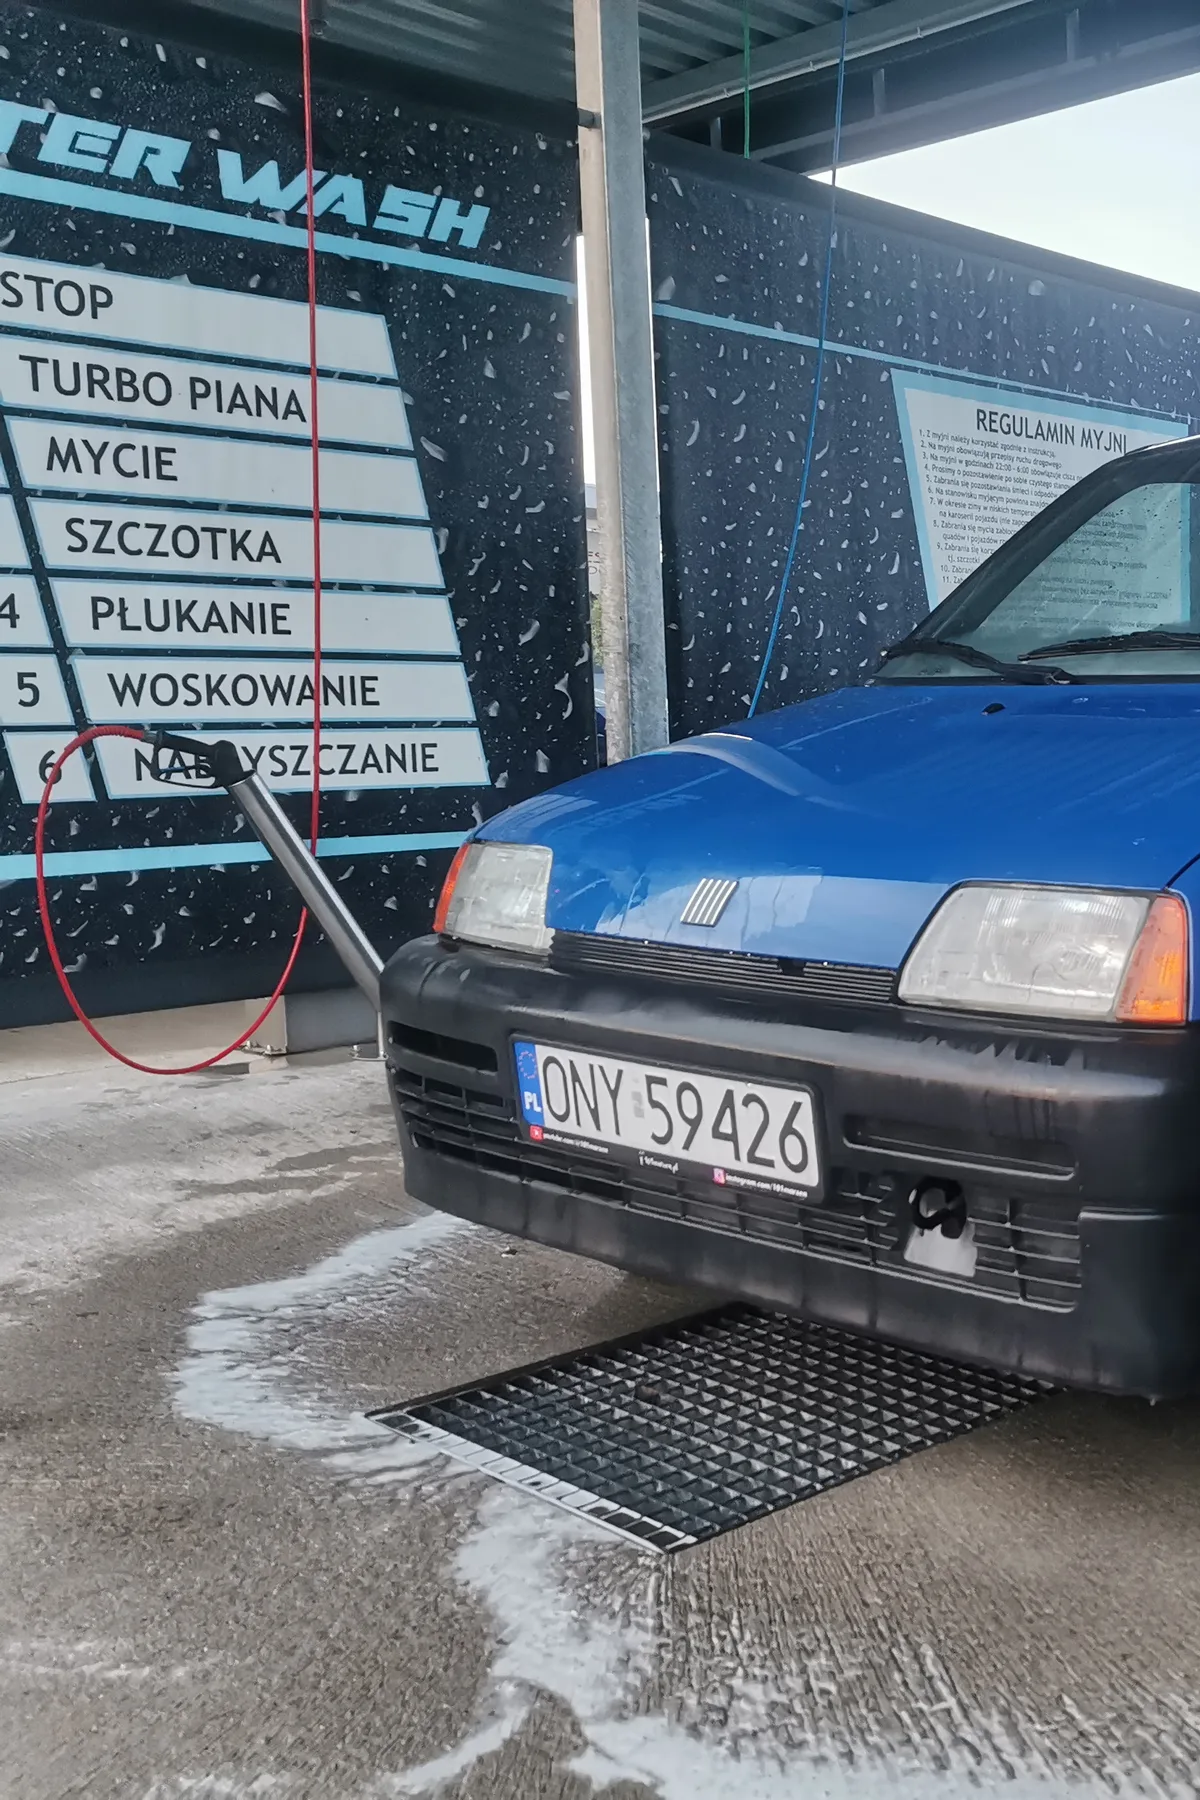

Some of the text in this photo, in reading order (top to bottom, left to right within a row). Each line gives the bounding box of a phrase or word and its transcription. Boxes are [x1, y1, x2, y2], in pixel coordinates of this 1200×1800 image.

[216, 148, 491, 249] WASH
[0, 270, 114, 320] STOP
[19, 354, 308, 424] TURBO PIANA
[976, 408, 1127, 454] REGULAMIN MYJNI
[46, 436, 179, 482] MYCIE
[66, 517, 282, 564] SZCZOTKA
[0, 593, 292, 636] 4 PŁUKANIE
[17, 671, 380, 708] 5 WOSKOWANIE
[38, 742, 440, 785] 6 NABYSZCZANIE
[524, 1091, 542, 1113] PL
[542, 1055, 809, 1174] ONY 59426
